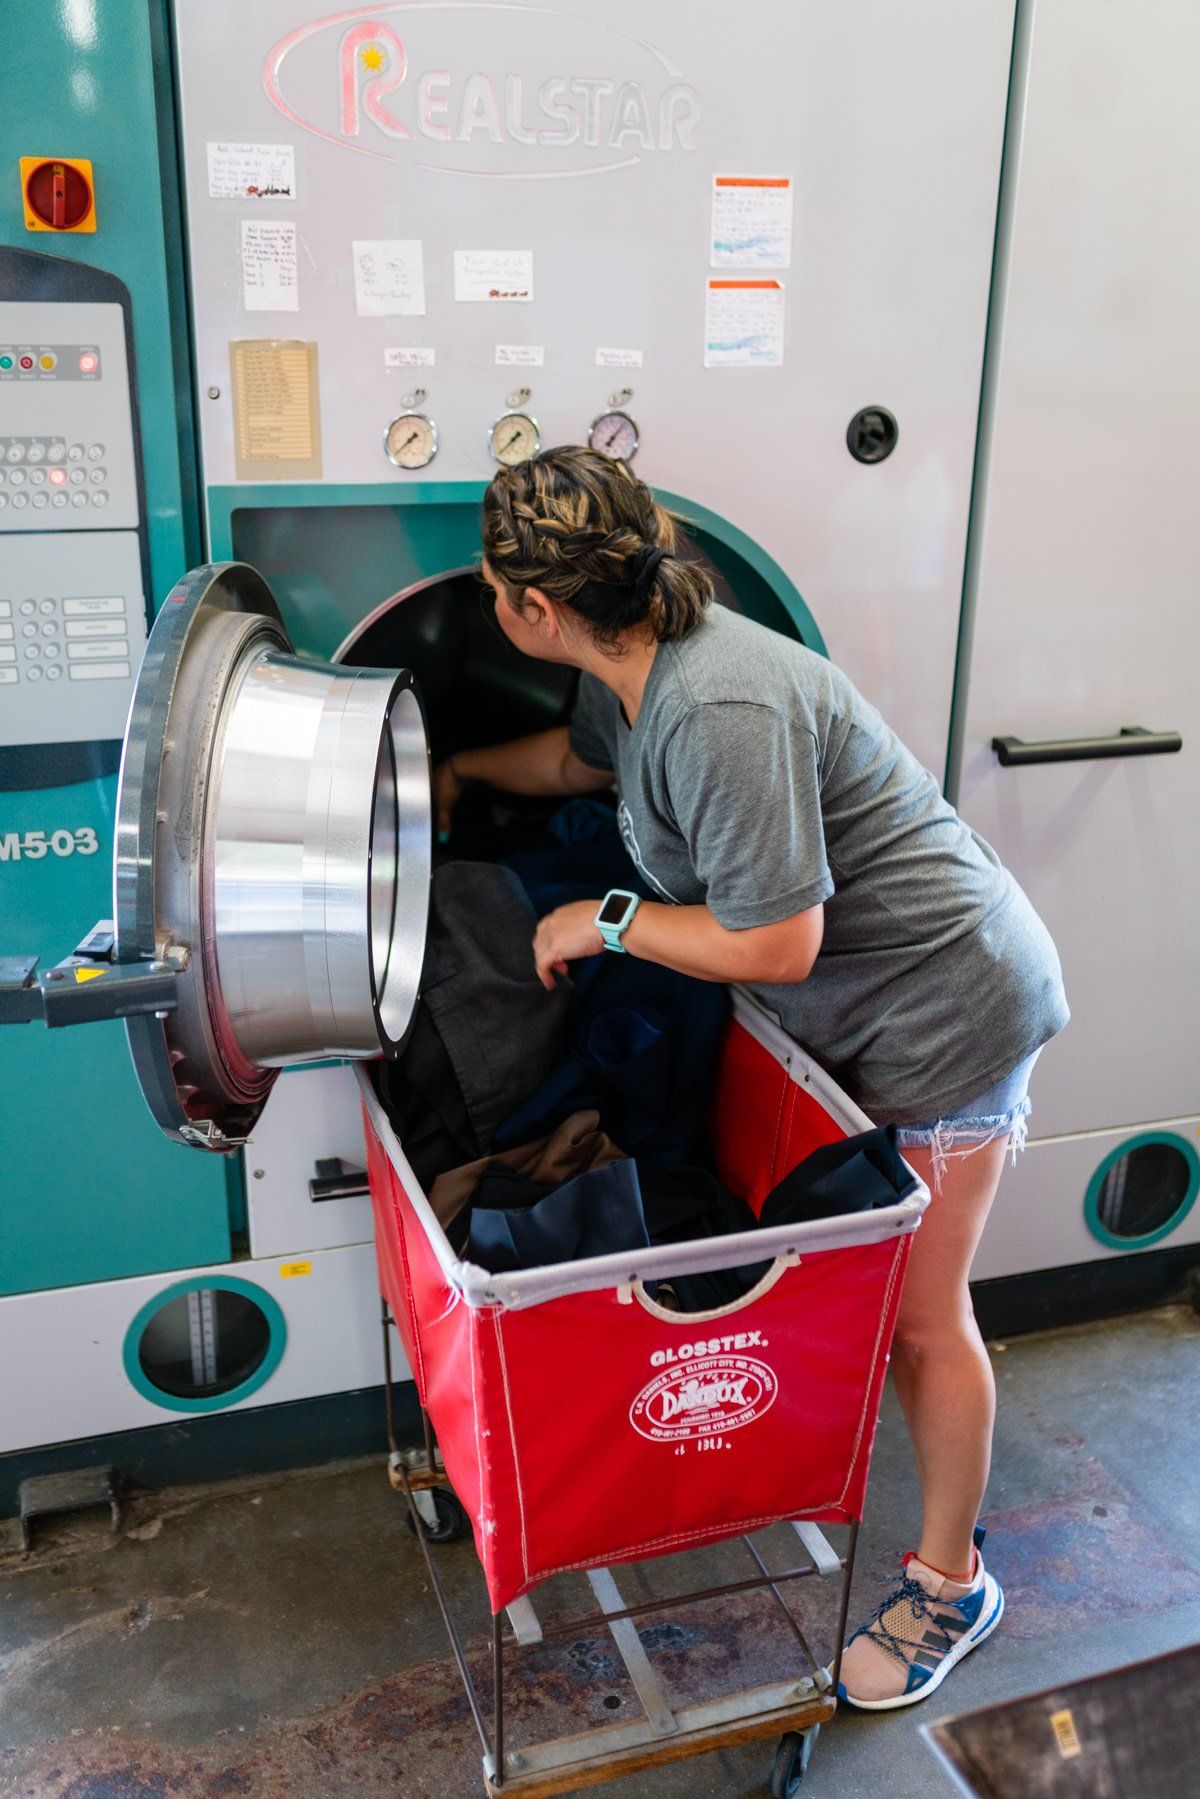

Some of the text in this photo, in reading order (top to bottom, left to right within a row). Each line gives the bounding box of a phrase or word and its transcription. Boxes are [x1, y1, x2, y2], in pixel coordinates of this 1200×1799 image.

[337, 20, 702, 151] REALSTAR
[0, 827, 99, 861] M503
[650, 1330, 769, 1367] GLOSSTEX.
[686, 1359, 717, 1373] ELLICOTT
